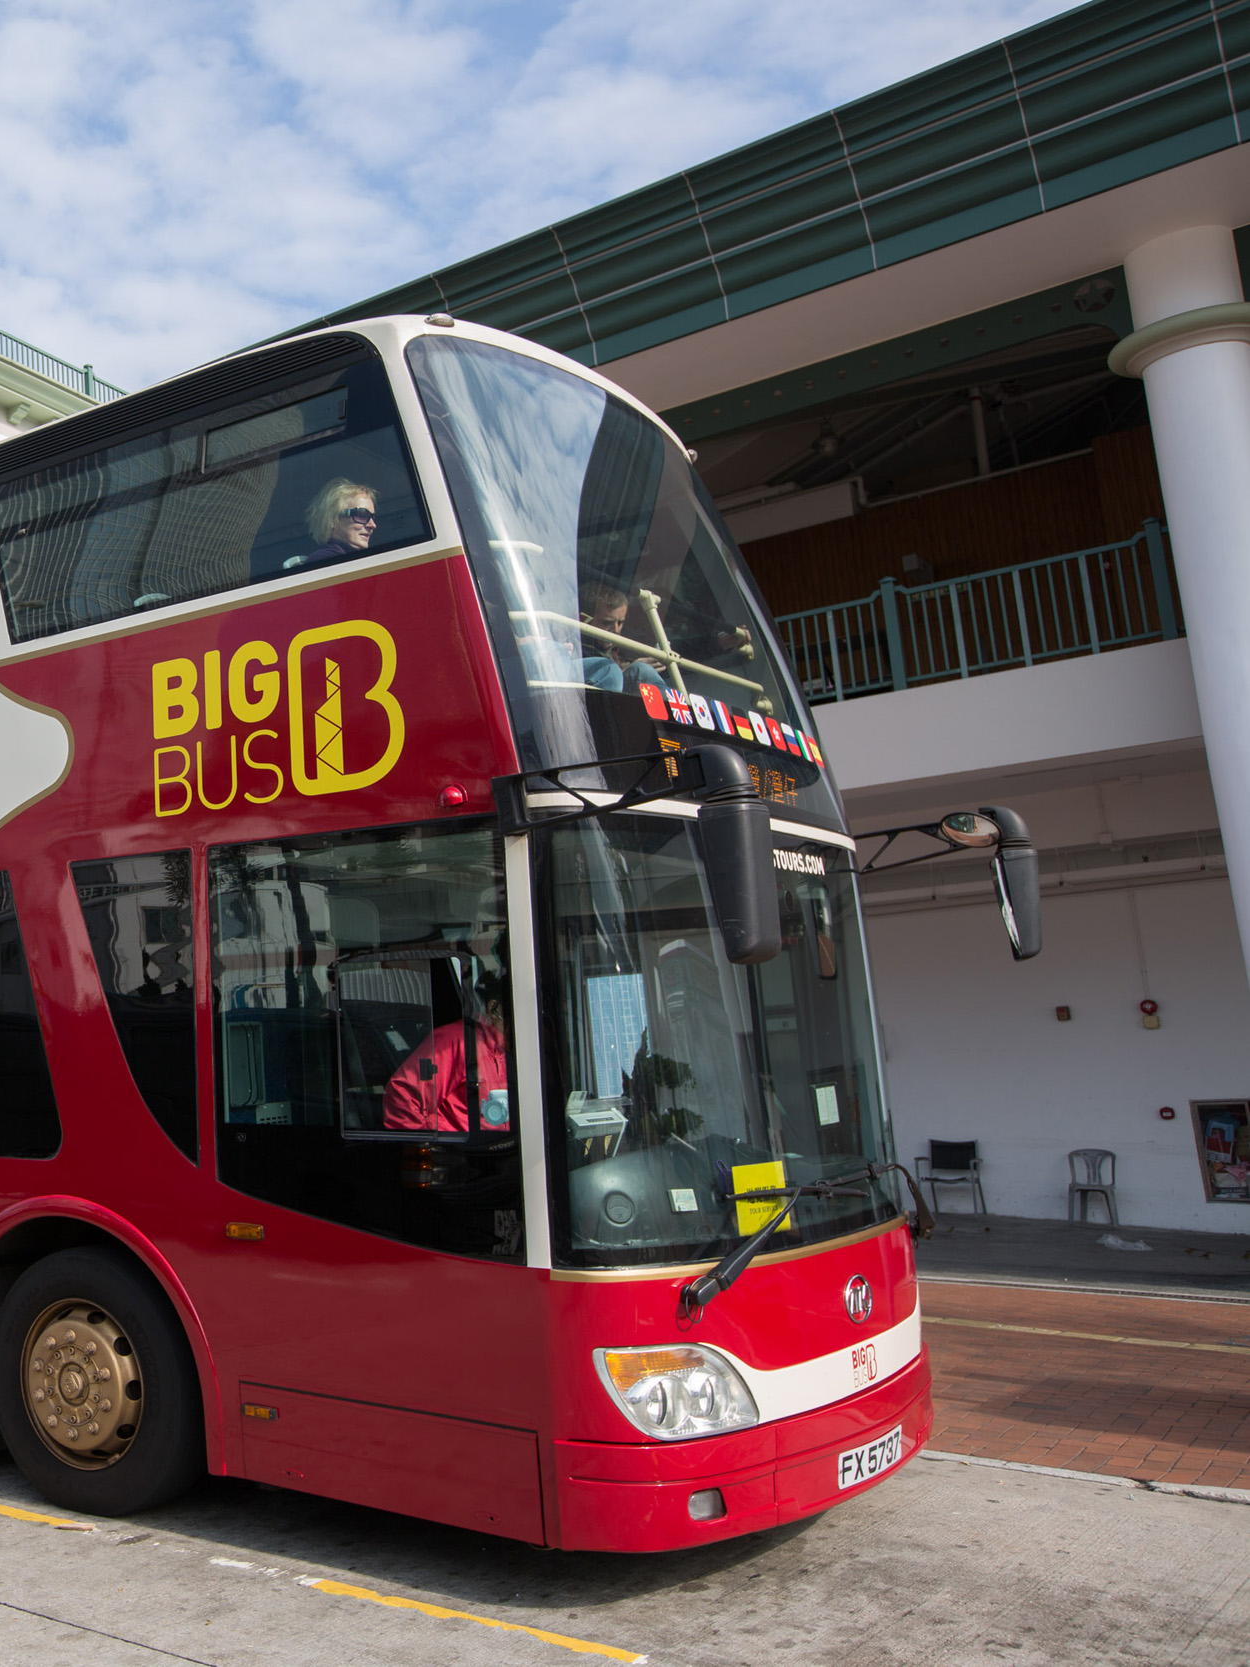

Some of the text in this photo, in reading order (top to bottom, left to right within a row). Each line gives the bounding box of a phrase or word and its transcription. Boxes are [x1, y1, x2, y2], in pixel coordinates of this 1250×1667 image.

[152, 640, 280, 740] BIG
[154, 729, 284, 817] BUS
[851, 1347, 866, 1368] BIG
[853, 1367, 867, 1389] BUS
[841, 1431, 900, 1485] FX 5737
